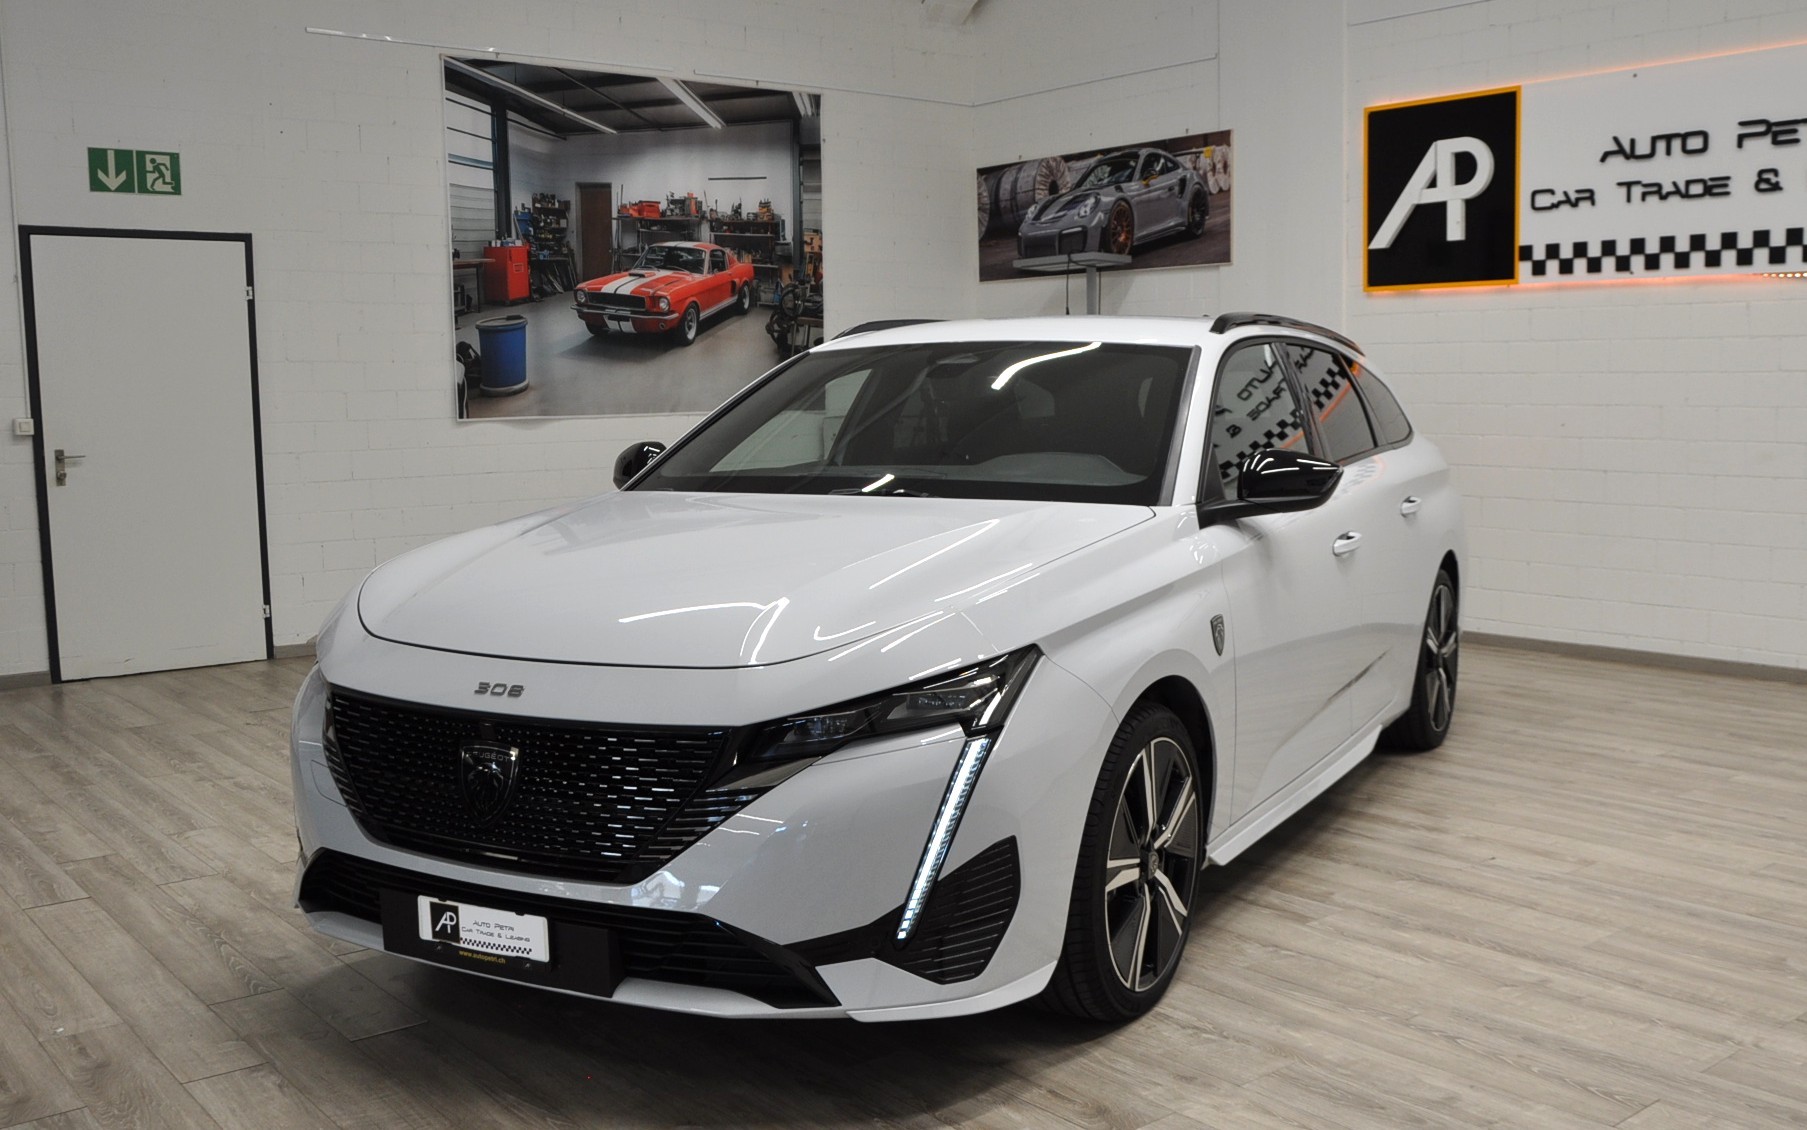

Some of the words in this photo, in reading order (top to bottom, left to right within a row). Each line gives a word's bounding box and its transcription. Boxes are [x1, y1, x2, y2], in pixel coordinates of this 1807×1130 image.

[1600, 130, 1709, 162] AUTO
[1737, 117, 1807, 149] PE
[1368, 136, 1495, 249] AP
[1531, 188, 1595, 211] CAR
[1616, 176, 1732, 203] TRADE
[1754, 168, 1783, 192] &
[474, 682, 525, 698] 308
[435, 911, 457, 933] AP
[473, 920, 490, 929] AUTO
